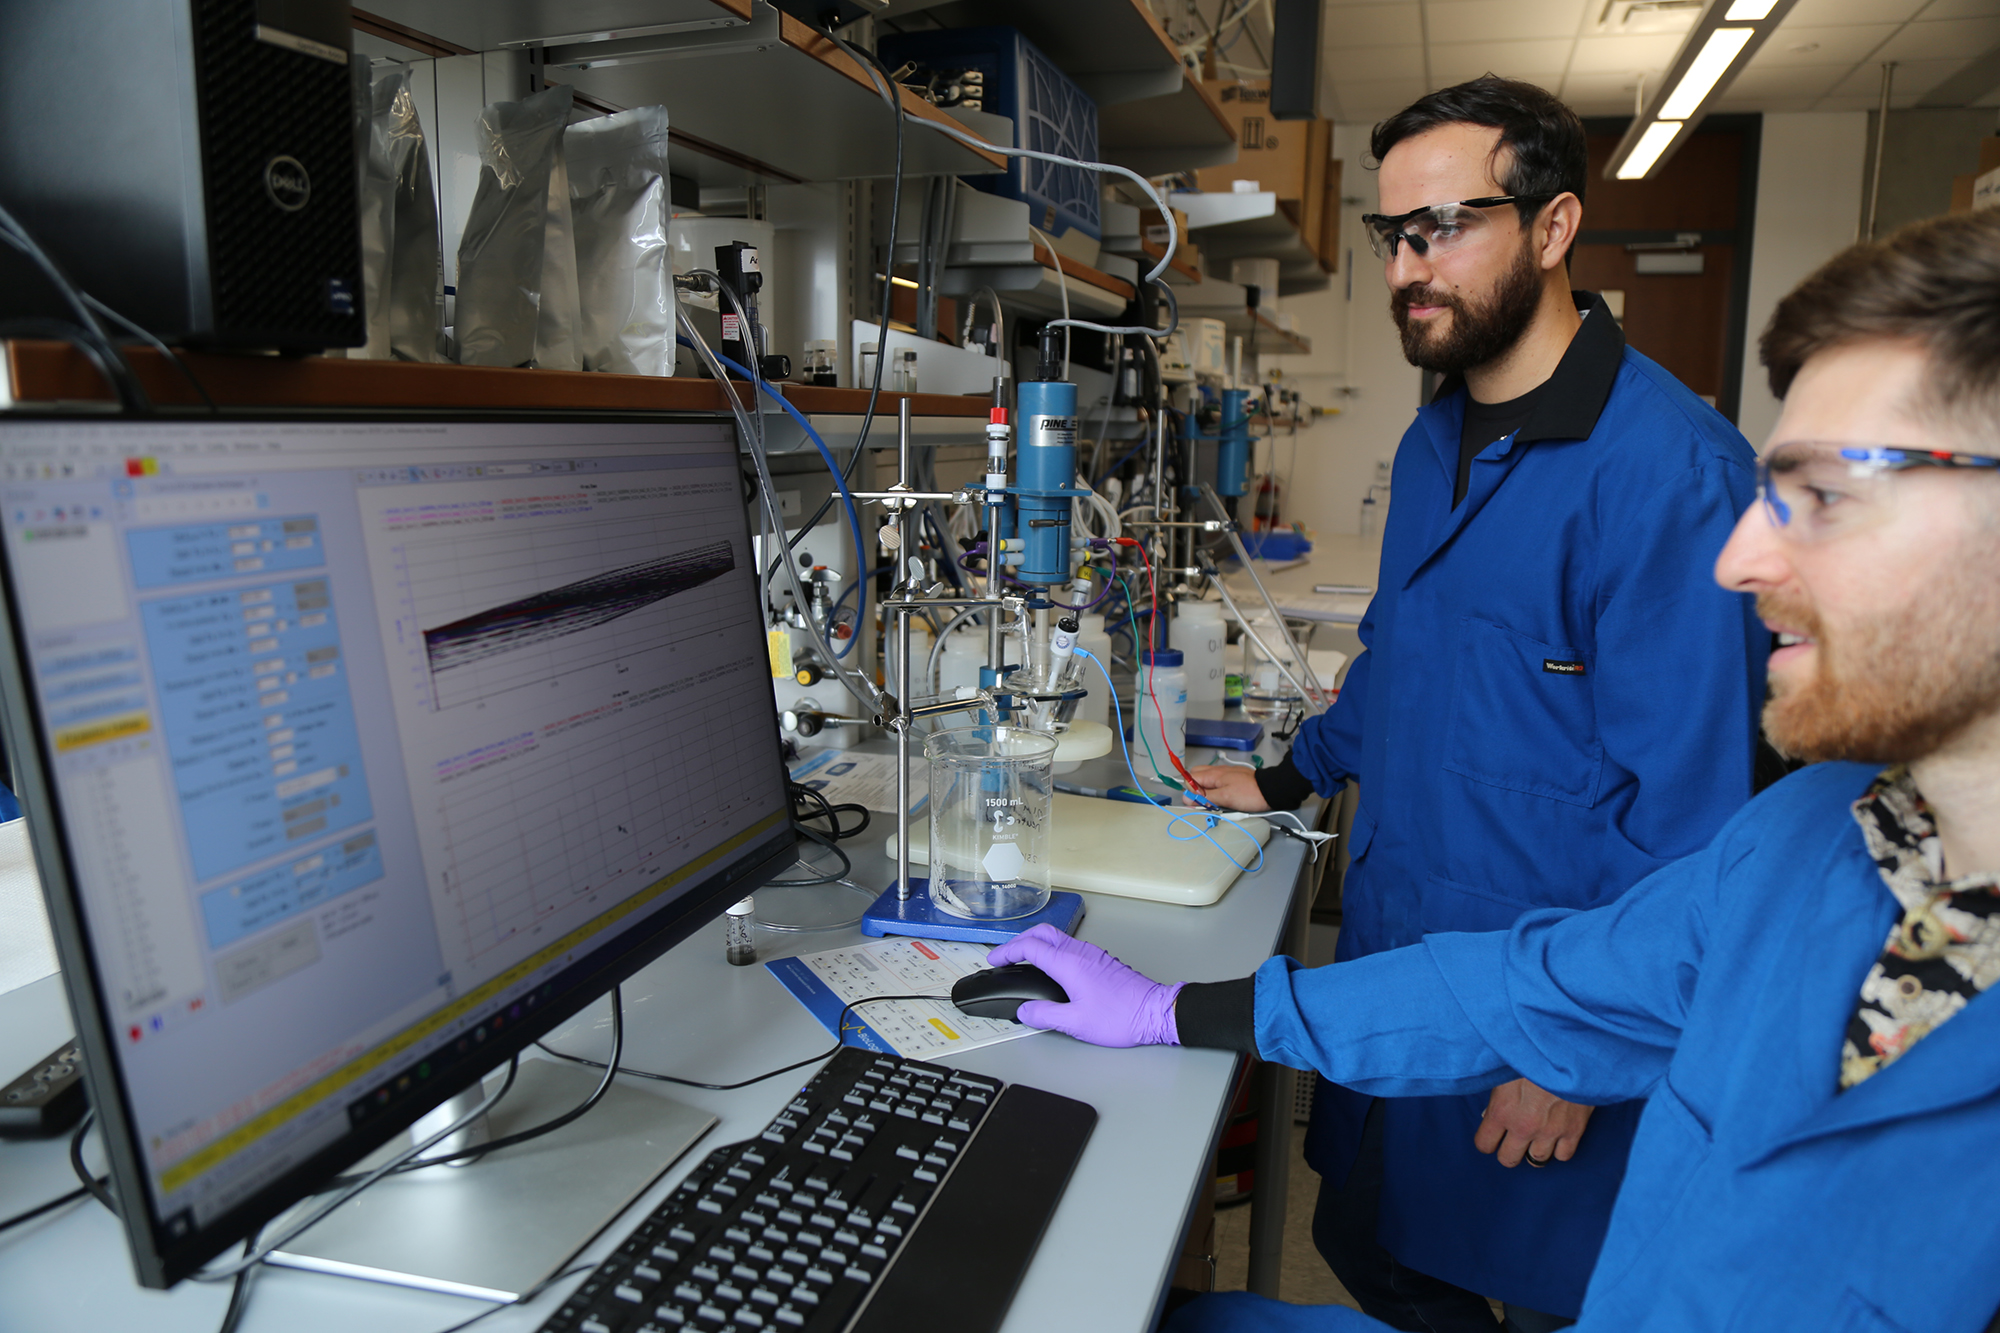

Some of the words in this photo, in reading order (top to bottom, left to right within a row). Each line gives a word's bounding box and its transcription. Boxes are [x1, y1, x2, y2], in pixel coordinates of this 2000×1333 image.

[272, 173, 305, 192] DELL
[985, 797, 1008, 807] 1500
[1009, 796, 1024, 806] mL
[857, 1033, 884, 1055] BioLogi
